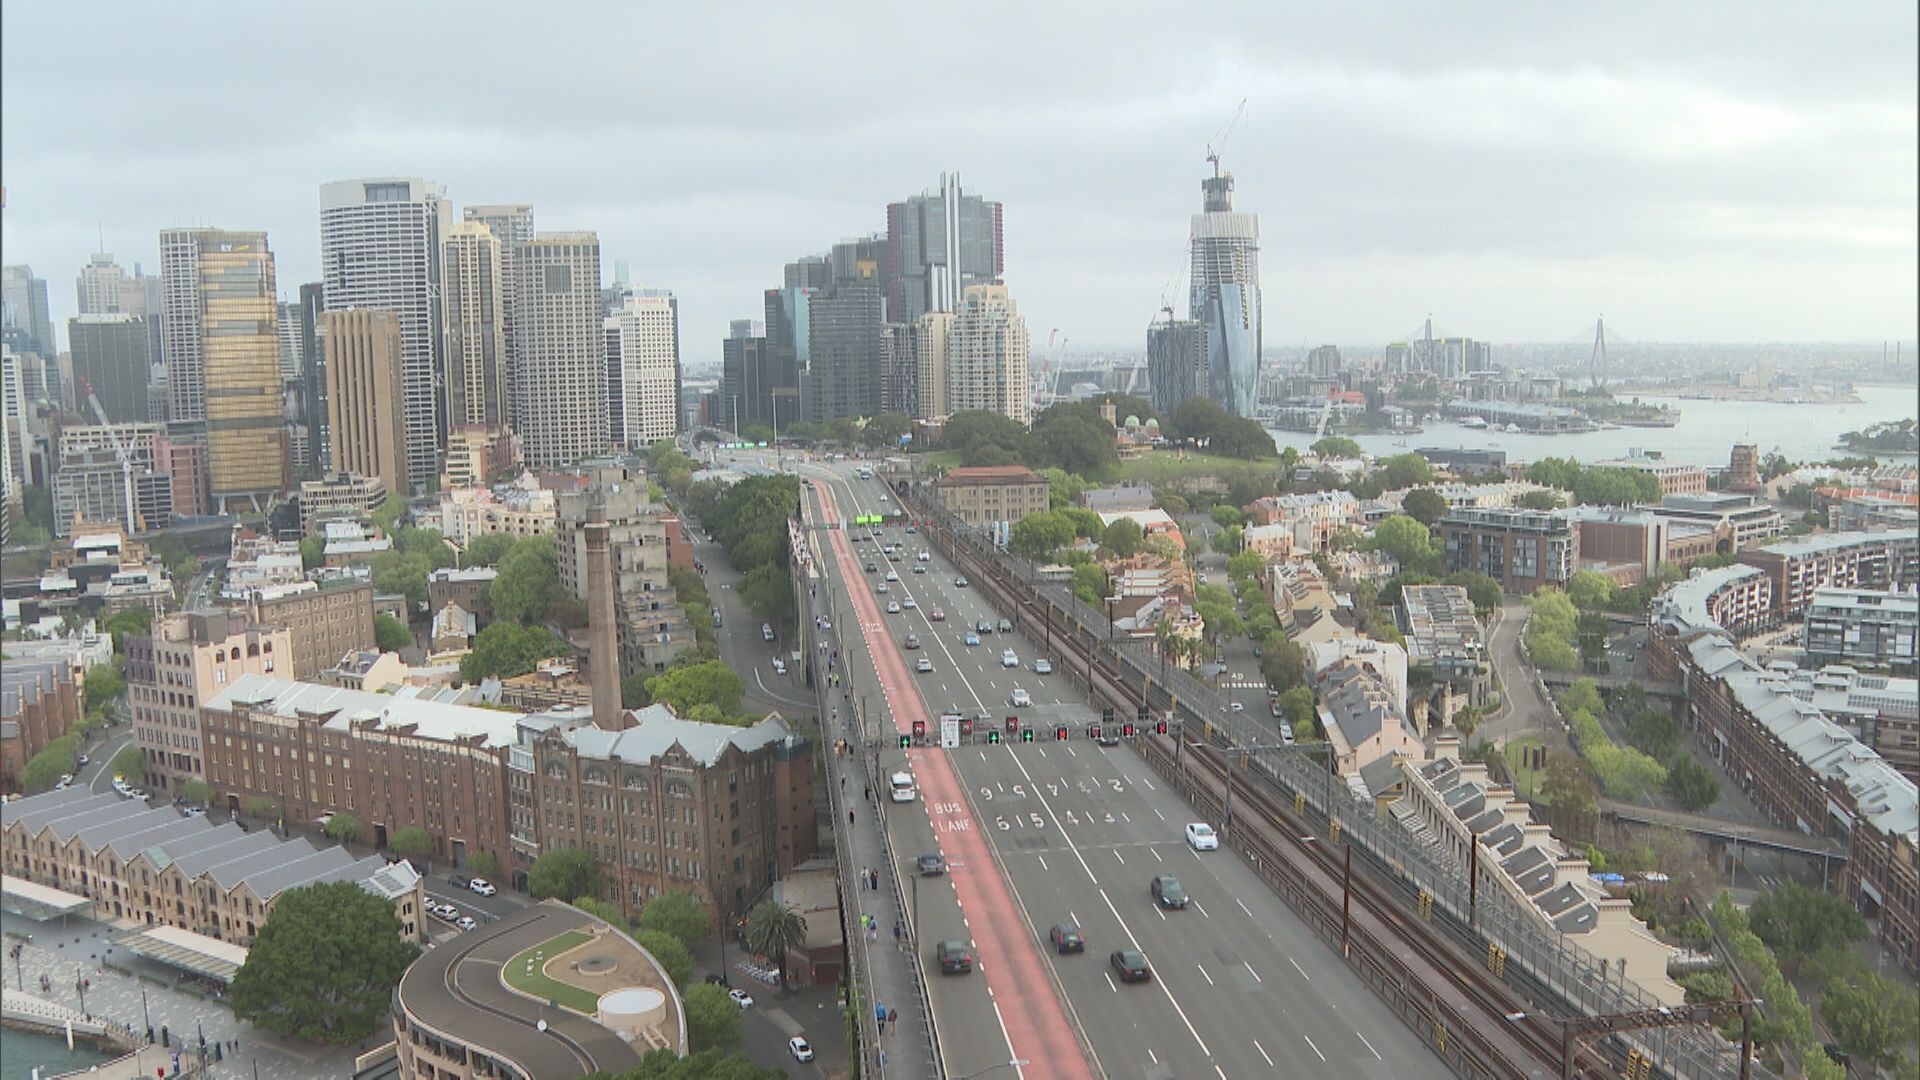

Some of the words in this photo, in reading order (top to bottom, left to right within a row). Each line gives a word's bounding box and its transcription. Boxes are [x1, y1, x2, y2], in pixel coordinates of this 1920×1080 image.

[934, 802, 962, 815] BUS
[938, 819, 970, 833] LANE
[996, 815, 1010, 830] 6
[1030, 813, 1044, 828] 5
